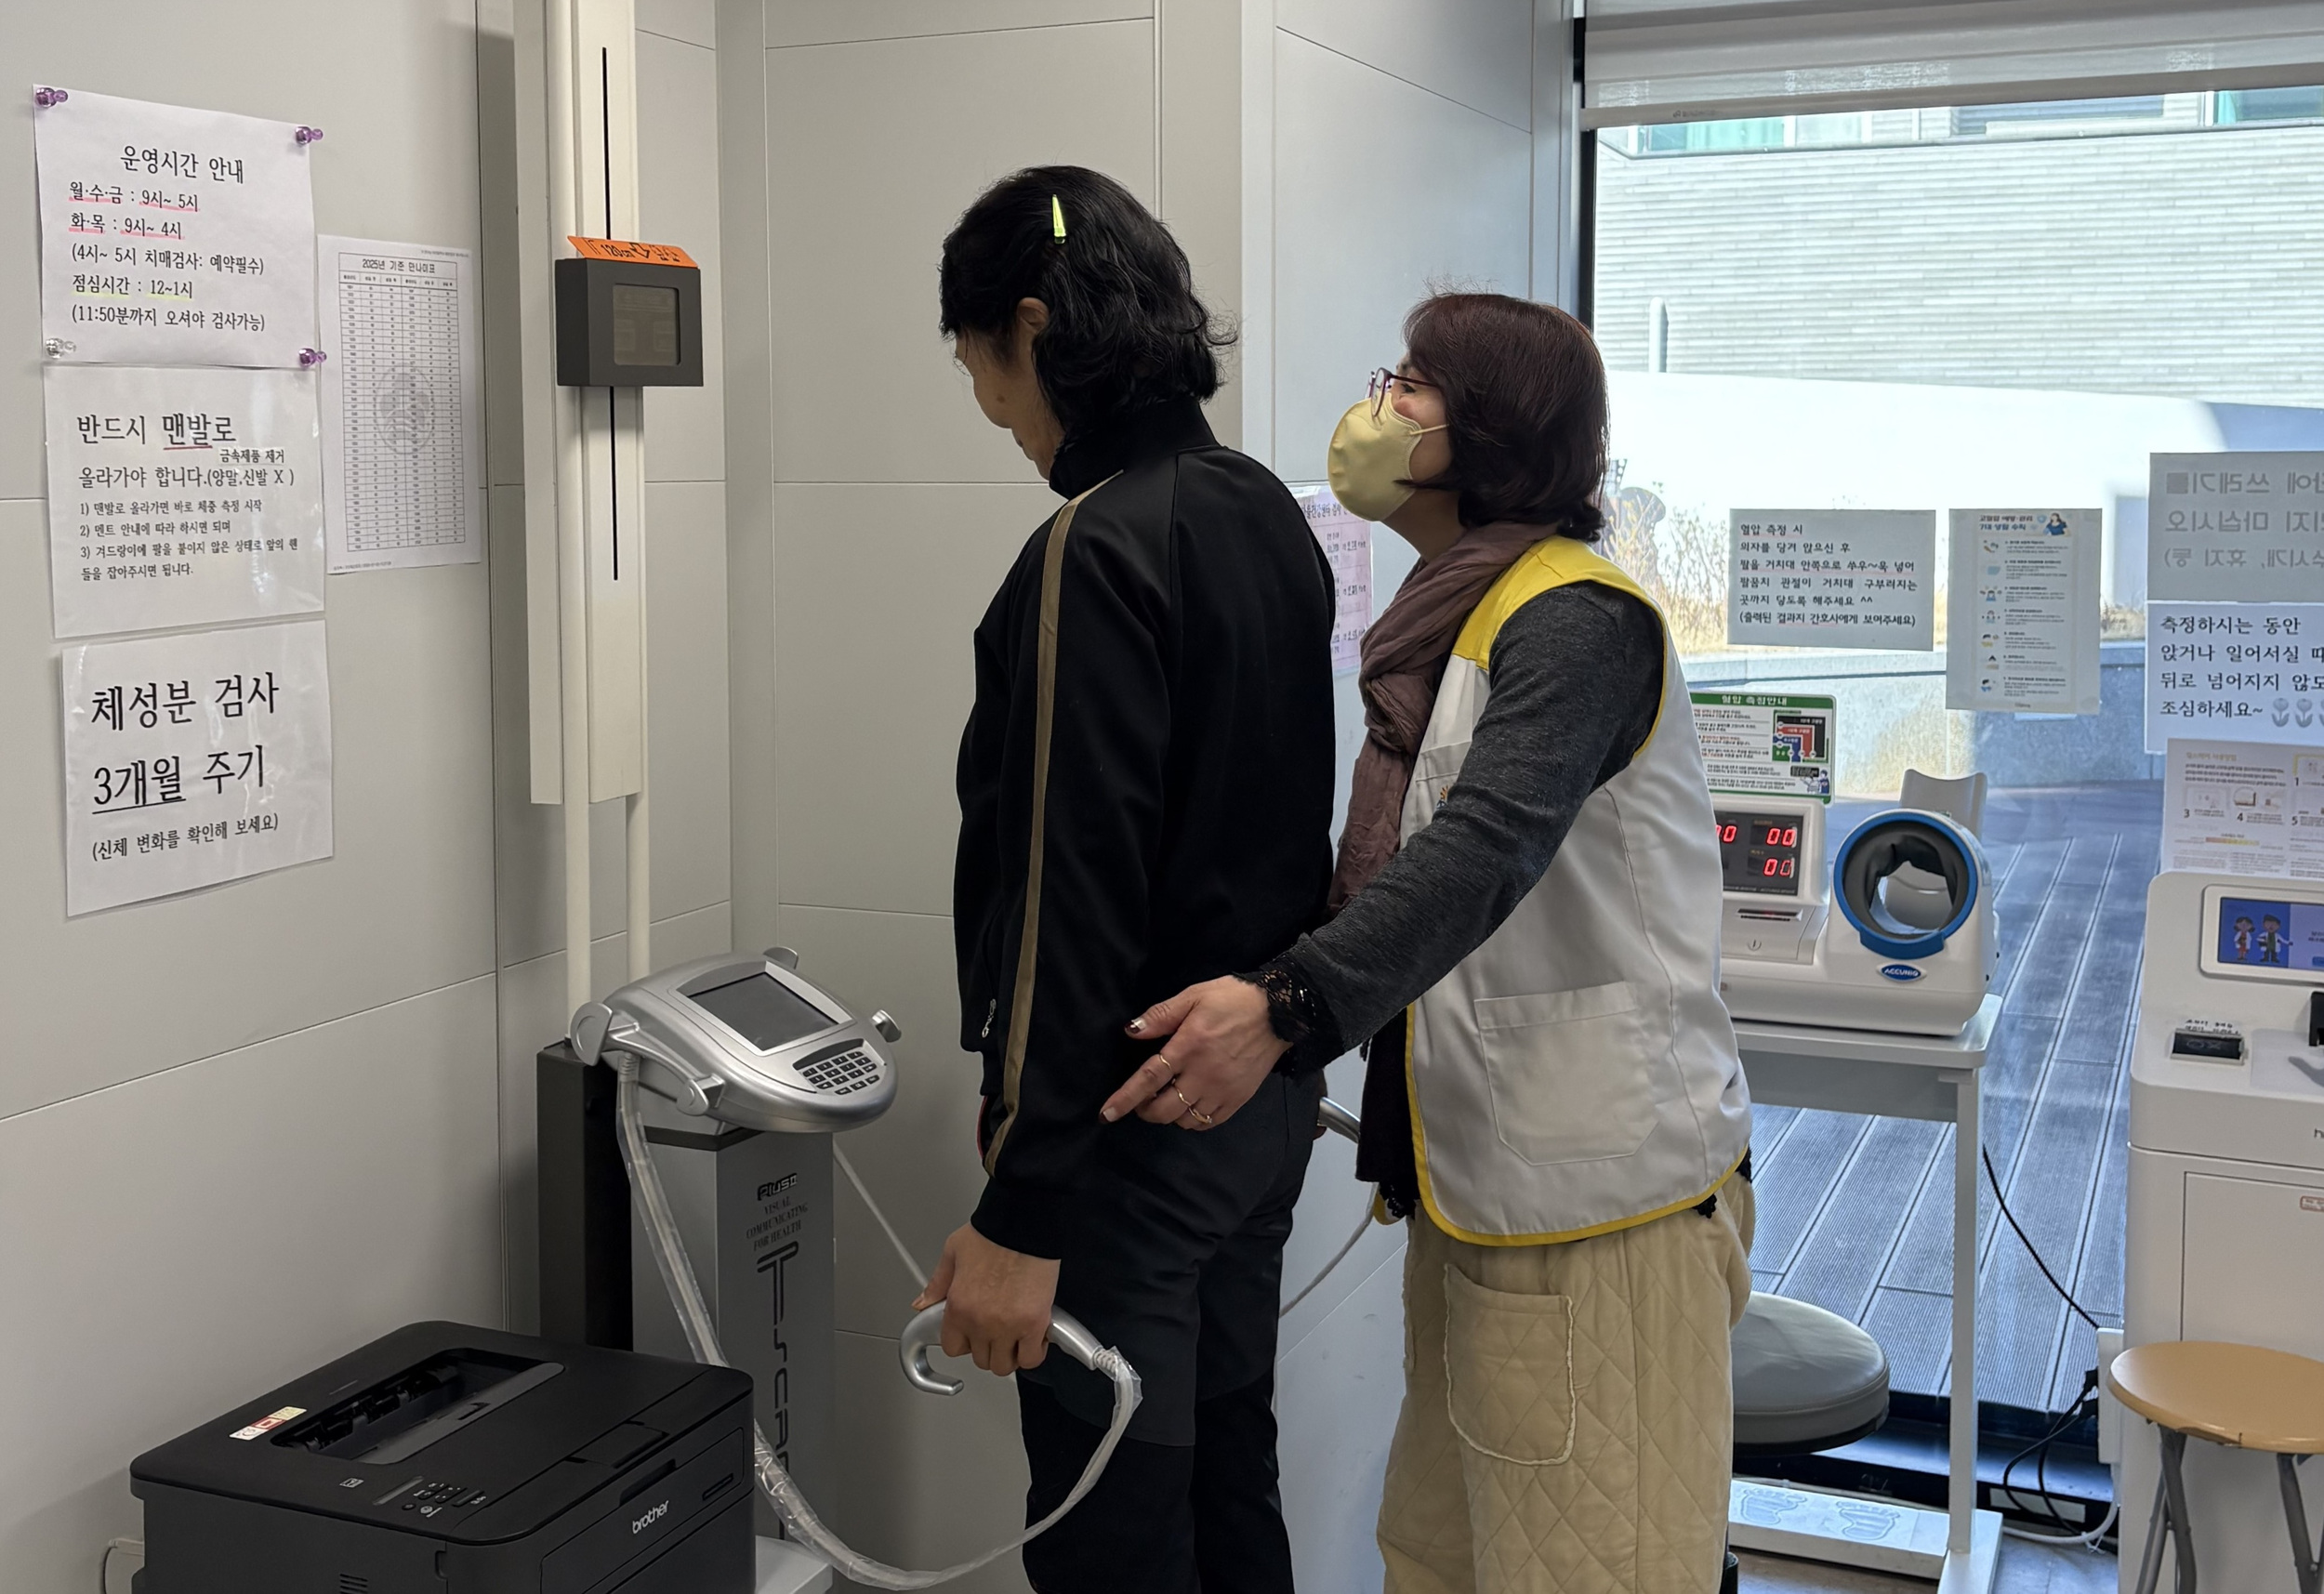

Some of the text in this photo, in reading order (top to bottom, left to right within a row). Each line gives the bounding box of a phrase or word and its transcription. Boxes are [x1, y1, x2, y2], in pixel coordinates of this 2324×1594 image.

[120, 145, 244, 184] 운영시간 안내
[70, 181, 123, 204] 월·수·금
[141, 190, 171, 208] 9시~
[178, 193, 198, 212] 5시
[70, 212, 104, 232] 화·목
[124, 217, 154, 237] 9시~
[161, 221, 181, 240] 4시
[72, 243, 264, 275] (4시~ 5시 치매검사: 예약필수)
[72, 274, 130, 295] 점심시간
[150, 280, 193, 298] 12~1시
[72, 306, 265, 332] (11:50분까지 오셔야 검사가능)
[77, 414, 236, 445] 반드시 맨발로
[220, 449, 284, 463] 금속제품 제거
[78, 467, 146, 488] 올라가야
[274, 469, 284, 484] X
[80, 499, 262, 516] 1) 맨발로 올라가면 바로 체중 측정 시작
[80, 520, 231, 538] 2) 멘트 안내에 따라 하시면 되며
[1740, 524, 1802, 536] 혈압 측정 시
[80, 546, 90, 560] 3)
[96, 544, 147, 558] 겨드랑이에
[152, 543, 172, 556] 팔을
[235, 539, 262, 553] 상태로
[267, 538, 284, 551] 앞의
[1740, 542, 1851, 554] 의자를 당겨 앉으신 후
[81, 562, 193, 581] 들을 잡아주시면 됩니다.
[1740, 560, 1760, 571] 팔을
[1766, 560, 1795, 570] 거치대
[1801, 560, 1842, 572] 안쪽으로
[1895, 561, 1914, 573] 넣어
[1740, 577, 1918, 591] 팔꿈치 관절이 거치대 구부러지는
[1740, 595, 1769, 606] 곳까지
[1776, 595, 1805, 606] 닿도록
[1813, 596, 1855, 607] 해주세요
[1739, 613, 1916, 627] (출력된 결과지 간호사에게 보여주세요)
[2160, 616, 2301, 636] 측정하시는 동안
[2161, 644, 2215, 662] 앉거나
[2226, 645, 2299, 664] 일어서실
[2160, 672, 2197, 690] 뒤로
[2208, 673, 2279, 691] 넘어지지
[91, 671, 280, 731] 체성분 검사
[2160, 700, 2263, 718] 조심하세요~
[93, 744, 264, 806] 3개월 주기
[2184, 809, 2190, 818] 3
[2237, 812, 2243, 822] 4
[2291, 816, 2298, 825] 5
[92, 812, 279, 862] (신체 변화를 확인해 보세요)
[1766, 828, 1795, 846] 00
[1764, 859, 1790, 876] 00
[764, 1196, 791, 1215] VISUAL
[746, 1203, 808, 1239] COMMUNICATING
[754, 1219, 801, 1251] FOR HEALTH
[632, 1500, 668, 1534] brother
